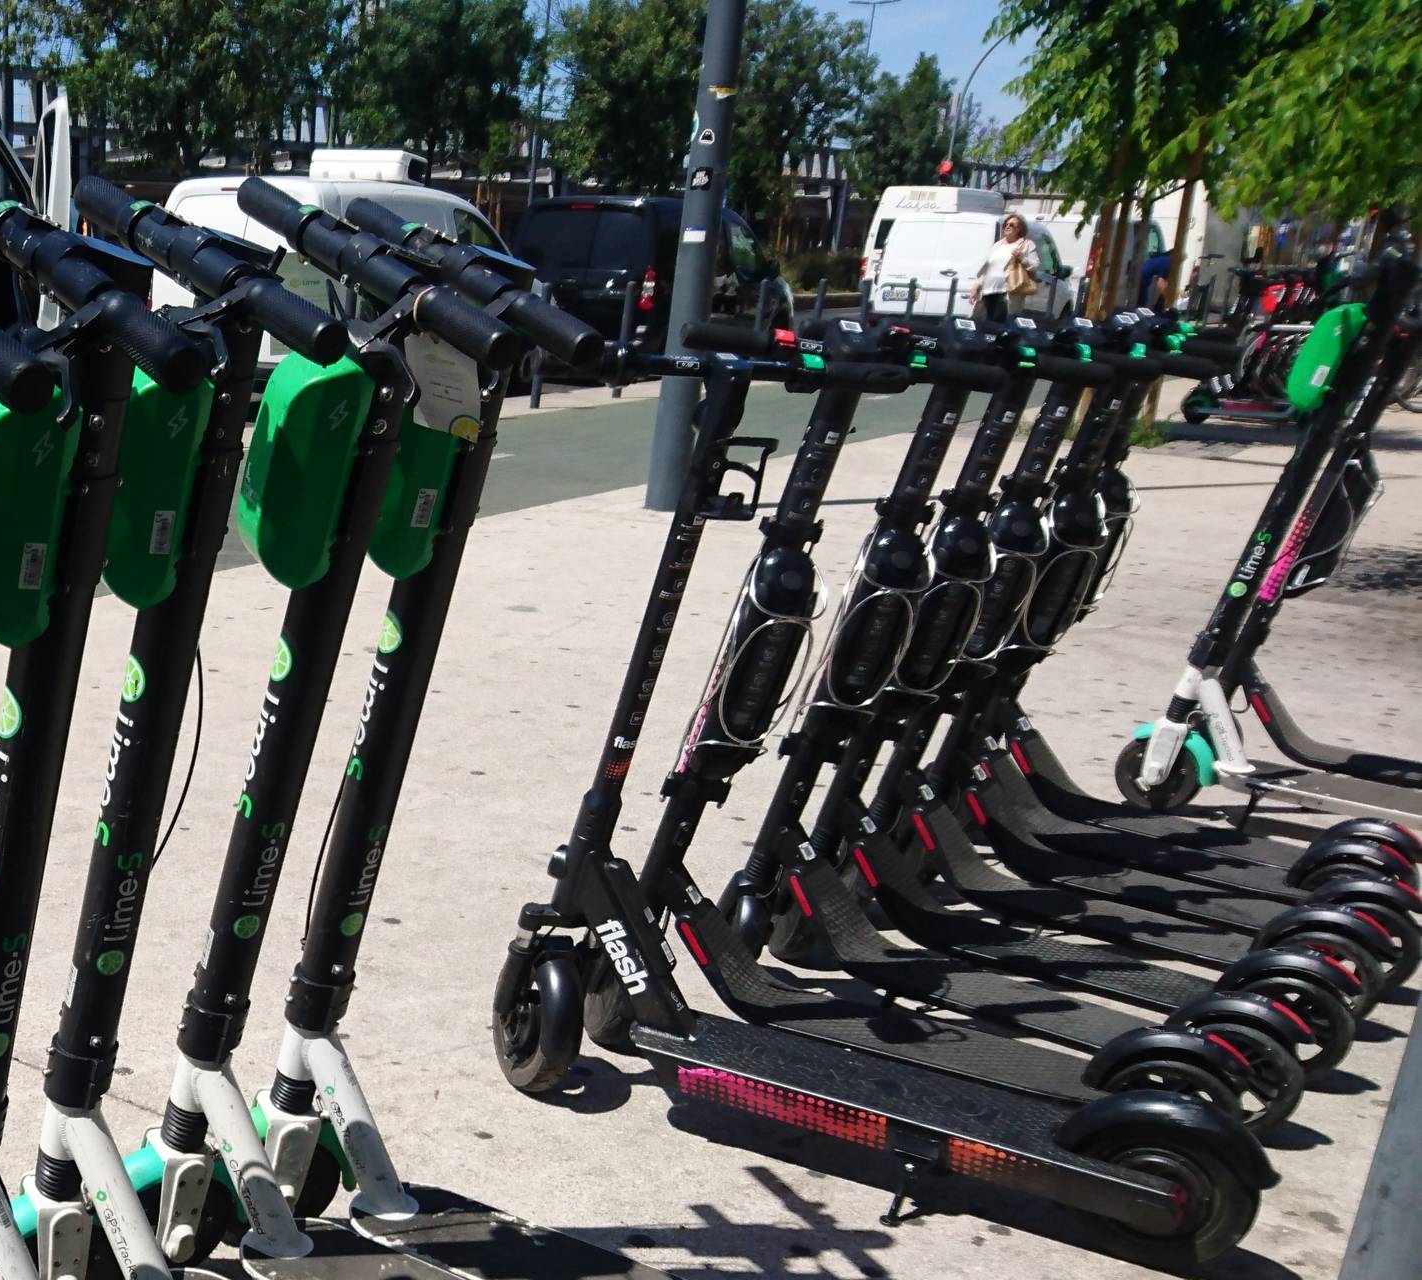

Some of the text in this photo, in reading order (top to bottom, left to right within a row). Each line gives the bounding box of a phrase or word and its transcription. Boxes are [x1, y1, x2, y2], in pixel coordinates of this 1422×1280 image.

[613, 735, 637, 750] flas
[595, 918, 649, 996] flash
[117, 1235, 139, 1280] Tracke
